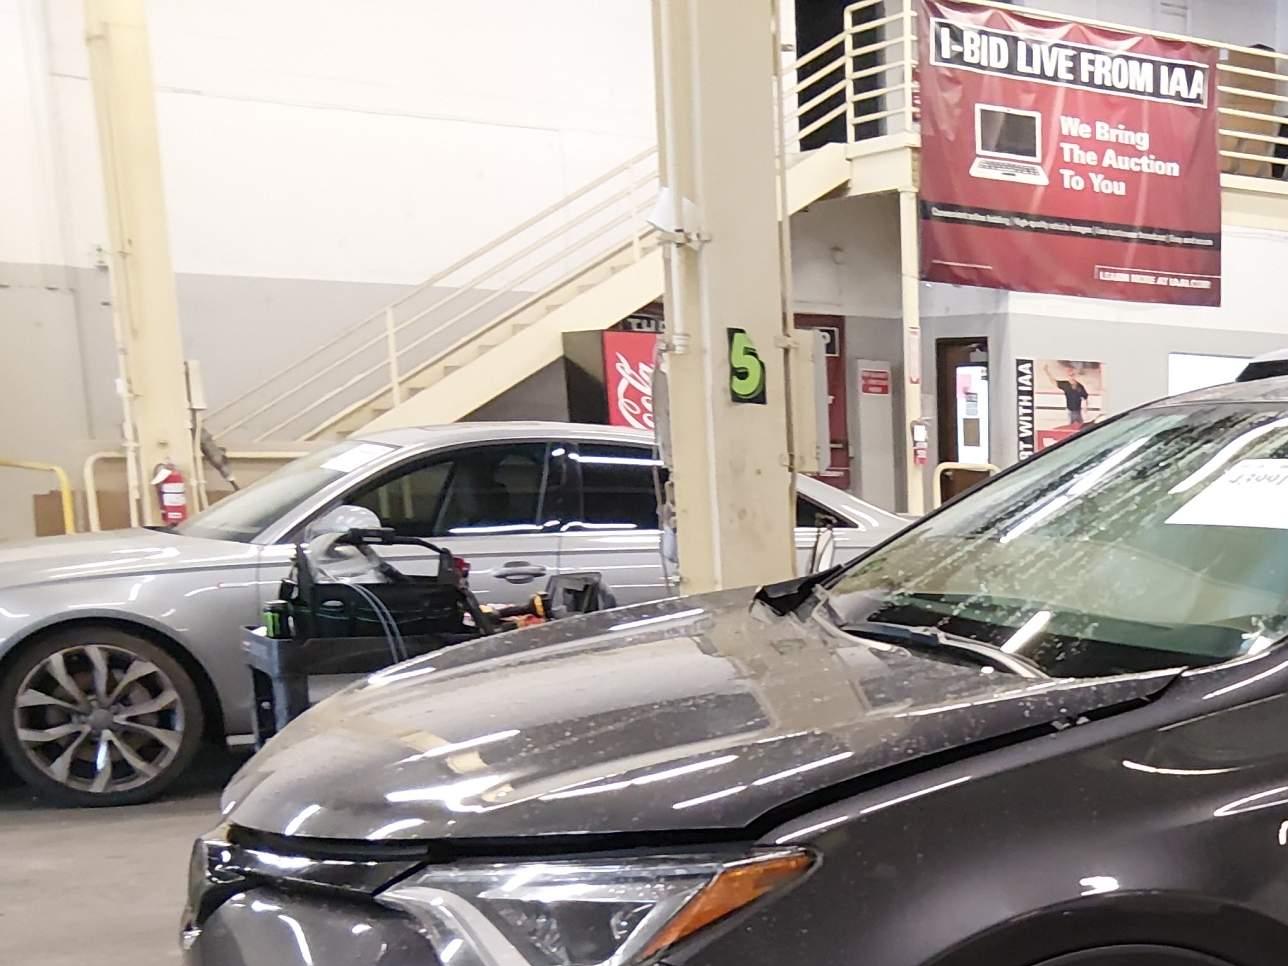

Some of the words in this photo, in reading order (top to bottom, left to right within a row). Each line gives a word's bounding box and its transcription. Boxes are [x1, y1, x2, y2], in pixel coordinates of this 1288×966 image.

[941, 27, 1009, 69] I-BID
[1017, 40, 1078, 80] LIVE
[1080, 51, 1154, 93] FROM
[1160, 65, 1204, 99] IAA
[1059, 115, 1092, 139] We
[1095, 121, 1150, 151] Bring
[1059, 142, 1098, 166] The
[1101, 148, 1180, 177] Auction
[1058, 168, 1086, 191] To
[1088, 172, 1126, 196] You
[731, 331, 762, 396] 5
[1017, 362, 1033, 391] IAA
[1018, 395, 1033, 438] WITH
